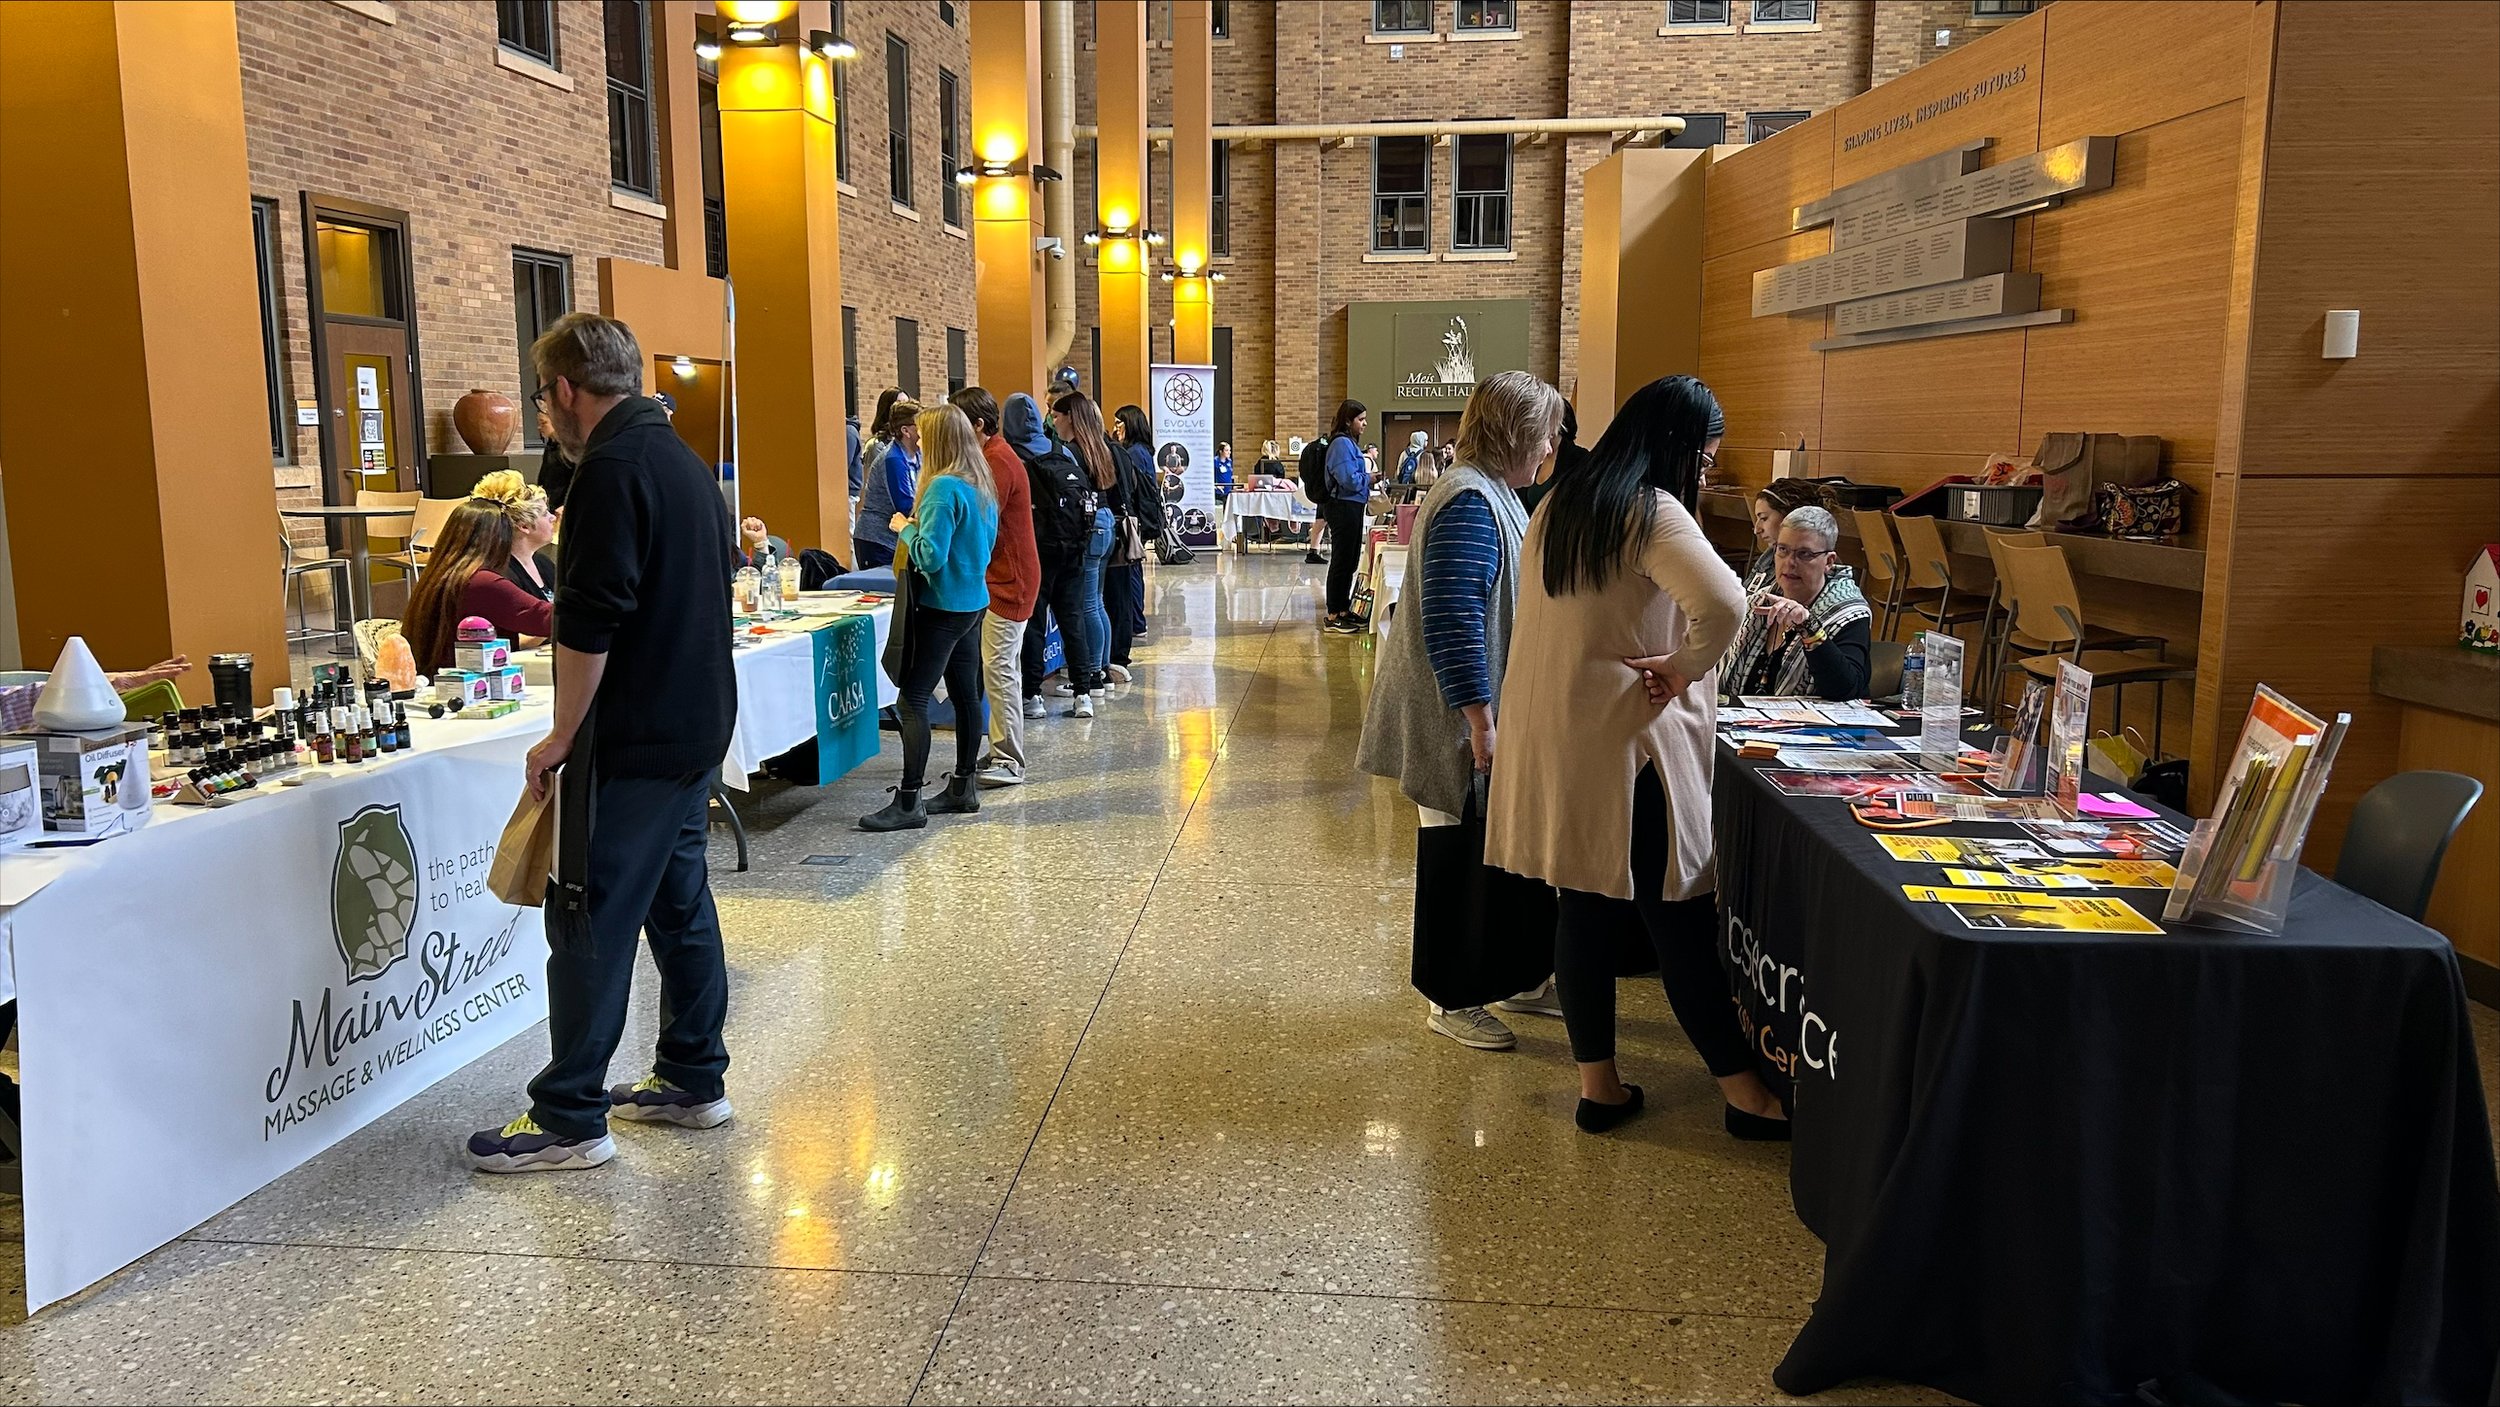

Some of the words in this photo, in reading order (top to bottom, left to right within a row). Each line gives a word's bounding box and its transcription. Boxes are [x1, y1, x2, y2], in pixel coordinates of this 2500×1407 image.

[1843, 125, 1882, 152] SHAPING
[1884, 112, 1913, 137] LIVES,
[1916, 88, 1970, 124] INSPIRING
[1973, 64, 2027, 102] FUTURES
[1397, 385, 1444, 397] RECITAL
[1406, 372, 1435, 384] Meis
[1163, 419, 1206, 428] EVOLVE
[828, 680, 865, 721] CAASA
[85, 753, 96, 763] Oil
[97, 748, 125, 761] Diffuser
[428, 856, 454, 881] the
[459, 840, 495, 877] path
[430, 892, 449, 912] to
[266, 987, 414, 1102] Main
[414, 905, 523, 1020] Street
[265, 1067, 357, 1142] MASSAGE
[361, 1060, 374, 1085] &
[378, 1008, 461, 1075] WELLNESS
[463, 973, 531, 1023] CENTER
